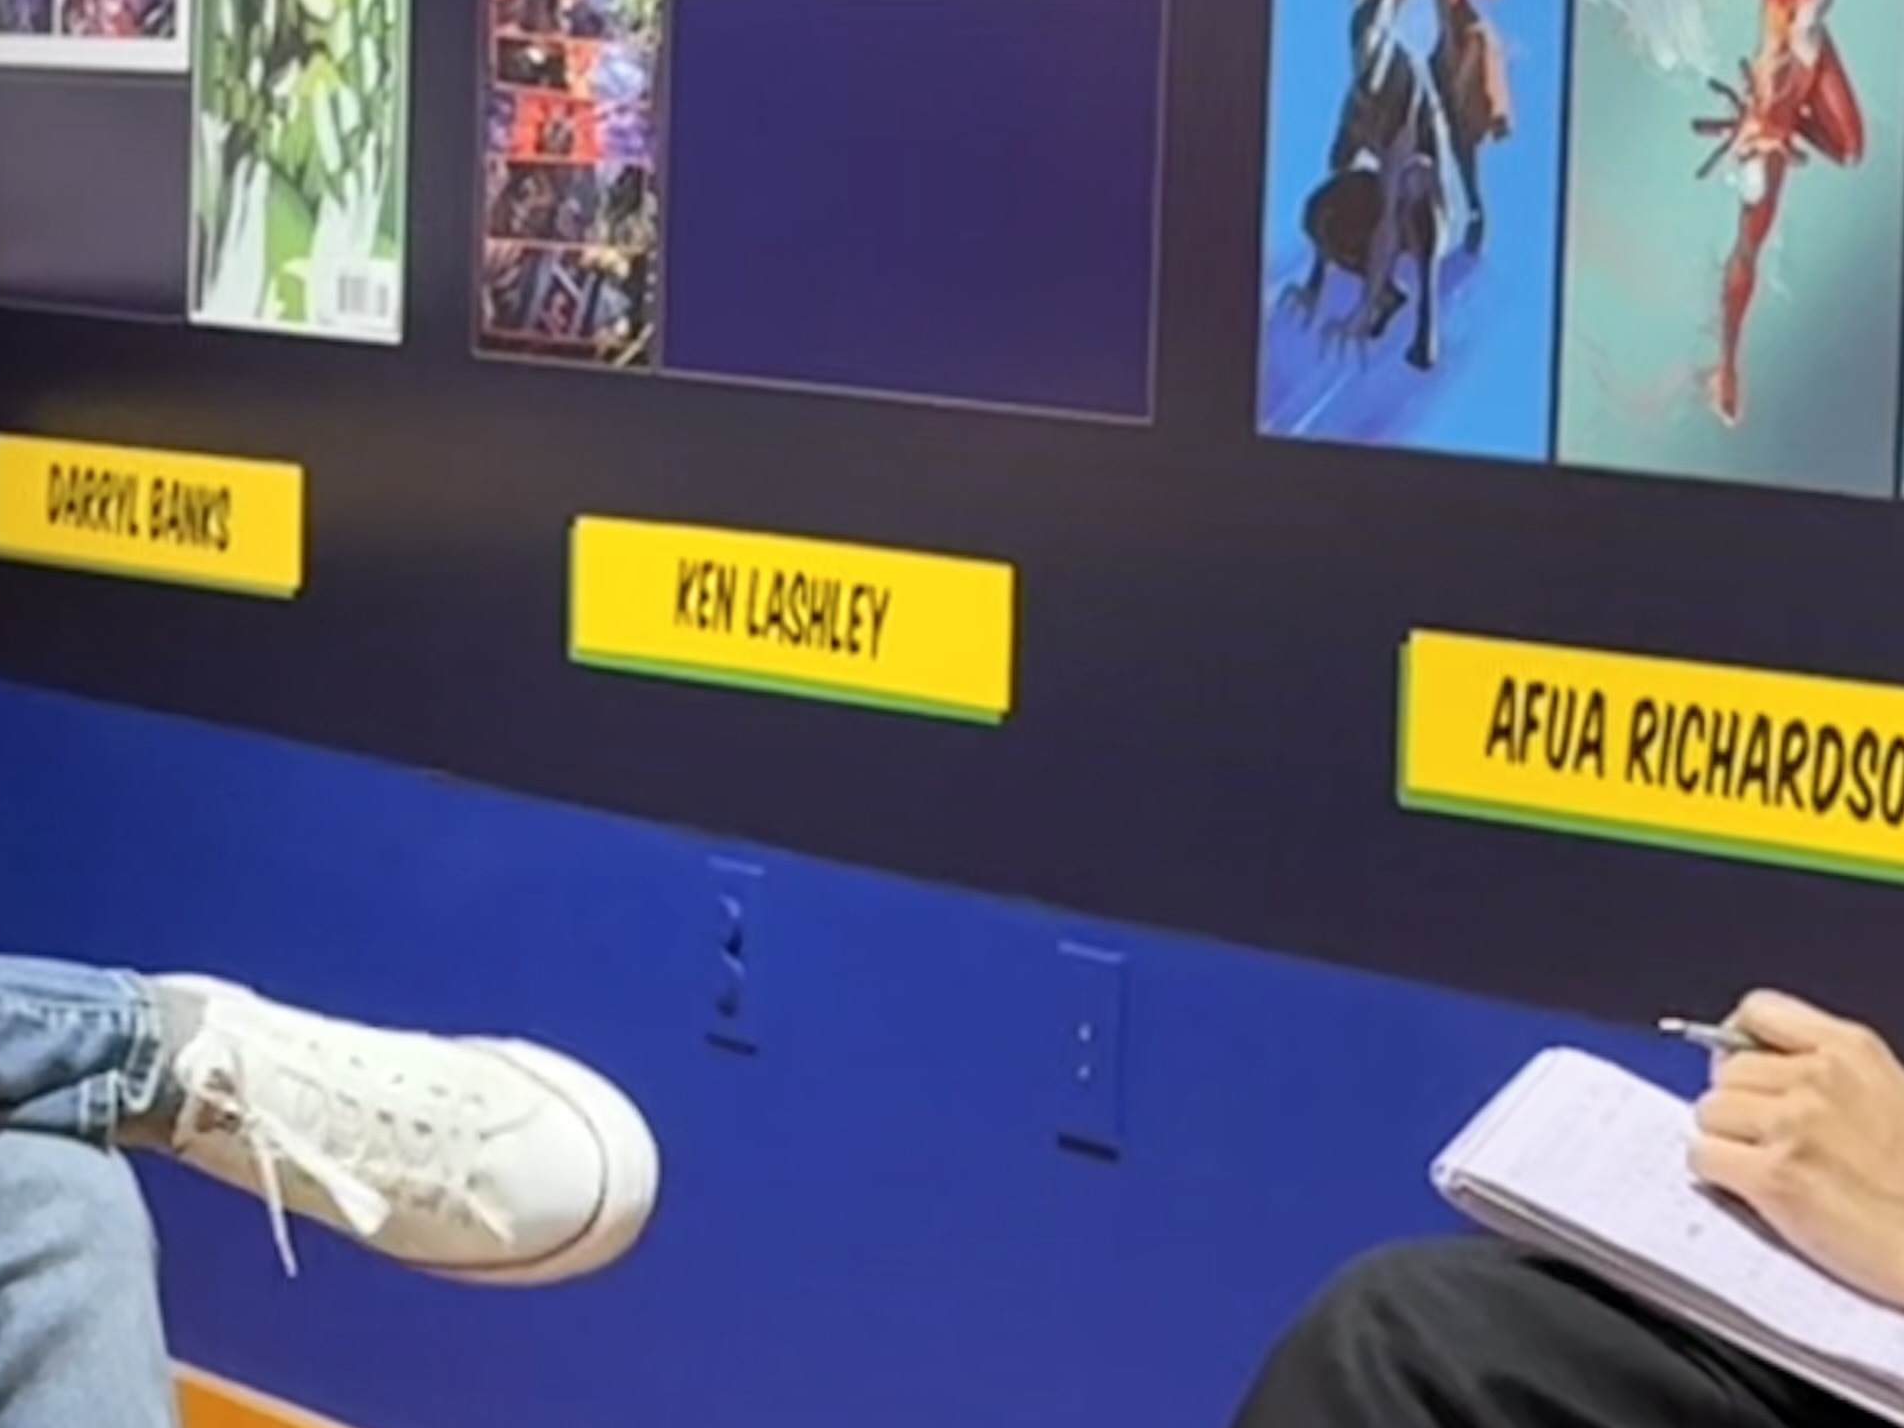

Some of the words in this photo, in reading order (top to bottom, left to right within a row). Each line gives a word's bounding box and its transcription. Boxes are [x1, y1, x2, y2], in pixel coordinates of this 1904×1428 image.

[47, 463, 138, 538] DARRYL
[149, 479, 232, 552] BANKS
[674, 558, 737, 632] KEN
[746, 566, 892, 660] LASHLEY
[1485, 674, 1607, 780] AFUA
